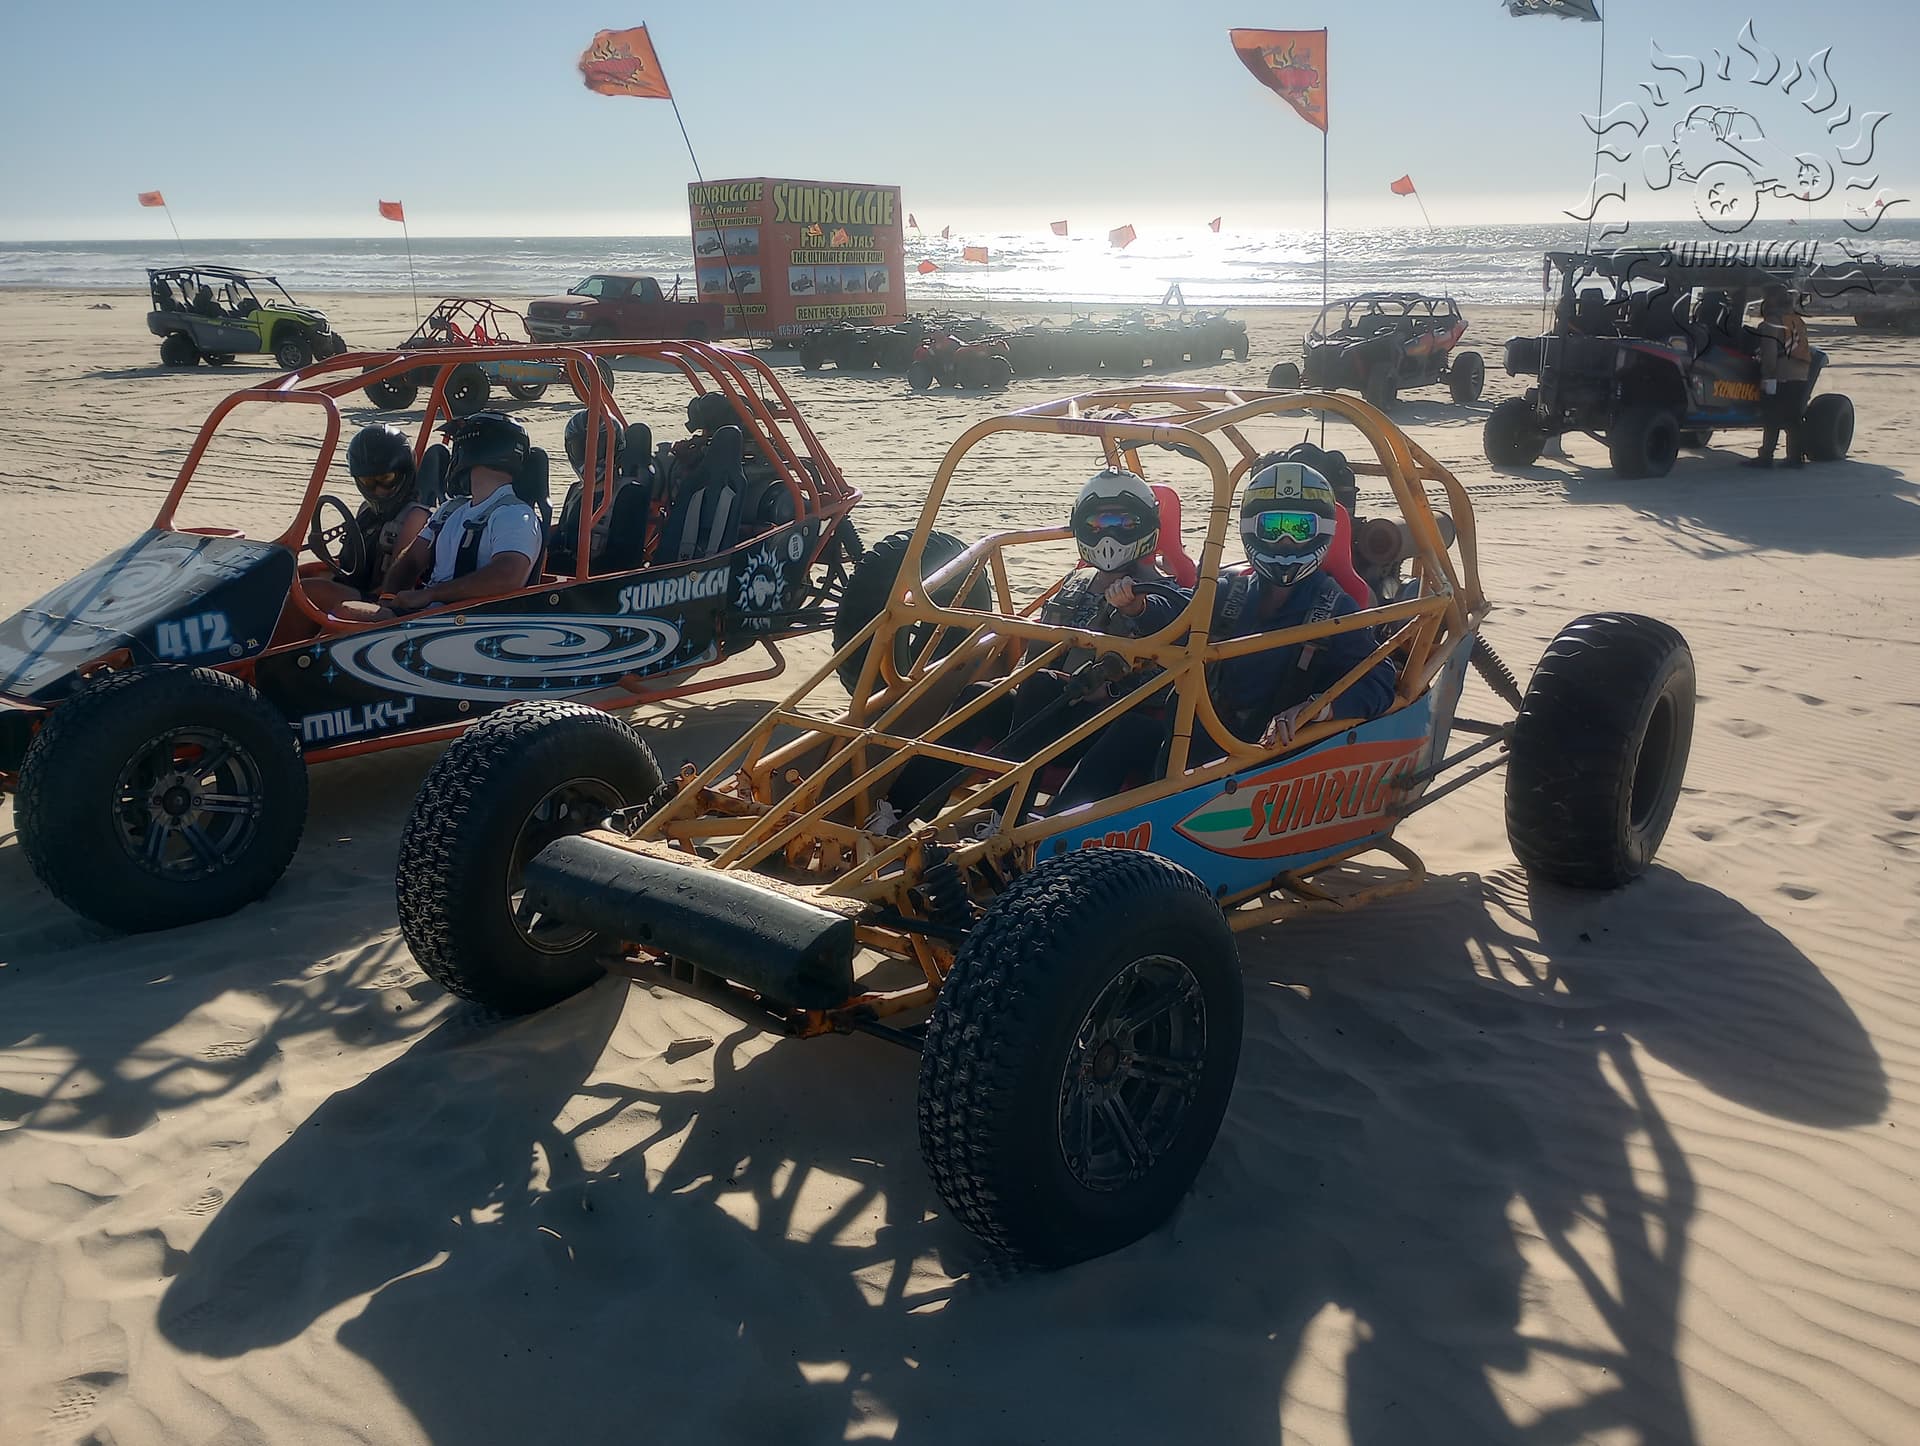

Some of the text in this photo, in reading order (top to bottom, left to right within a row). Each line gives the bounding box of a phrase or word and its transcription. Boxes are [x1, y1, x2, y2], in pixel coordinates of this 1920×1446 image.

[773, 182, 894, 225] SUNBUGGIE
[793, 251, 806, 263] THE
[809, 251, 840, 263] ULTIMATE
[842, 251, 866, 263] FAMILY
[798, 307, 819, 320] RENT
[820, 306, 840, 319] HERE
[848, 304, 865, 317] RIDE
[866, 304, 885, 316] NOW
[618, 565, 731, 616] SUNBUGGY
[157, 611, 232, 657] 412
[302, 696, 416, 742] MILKY
